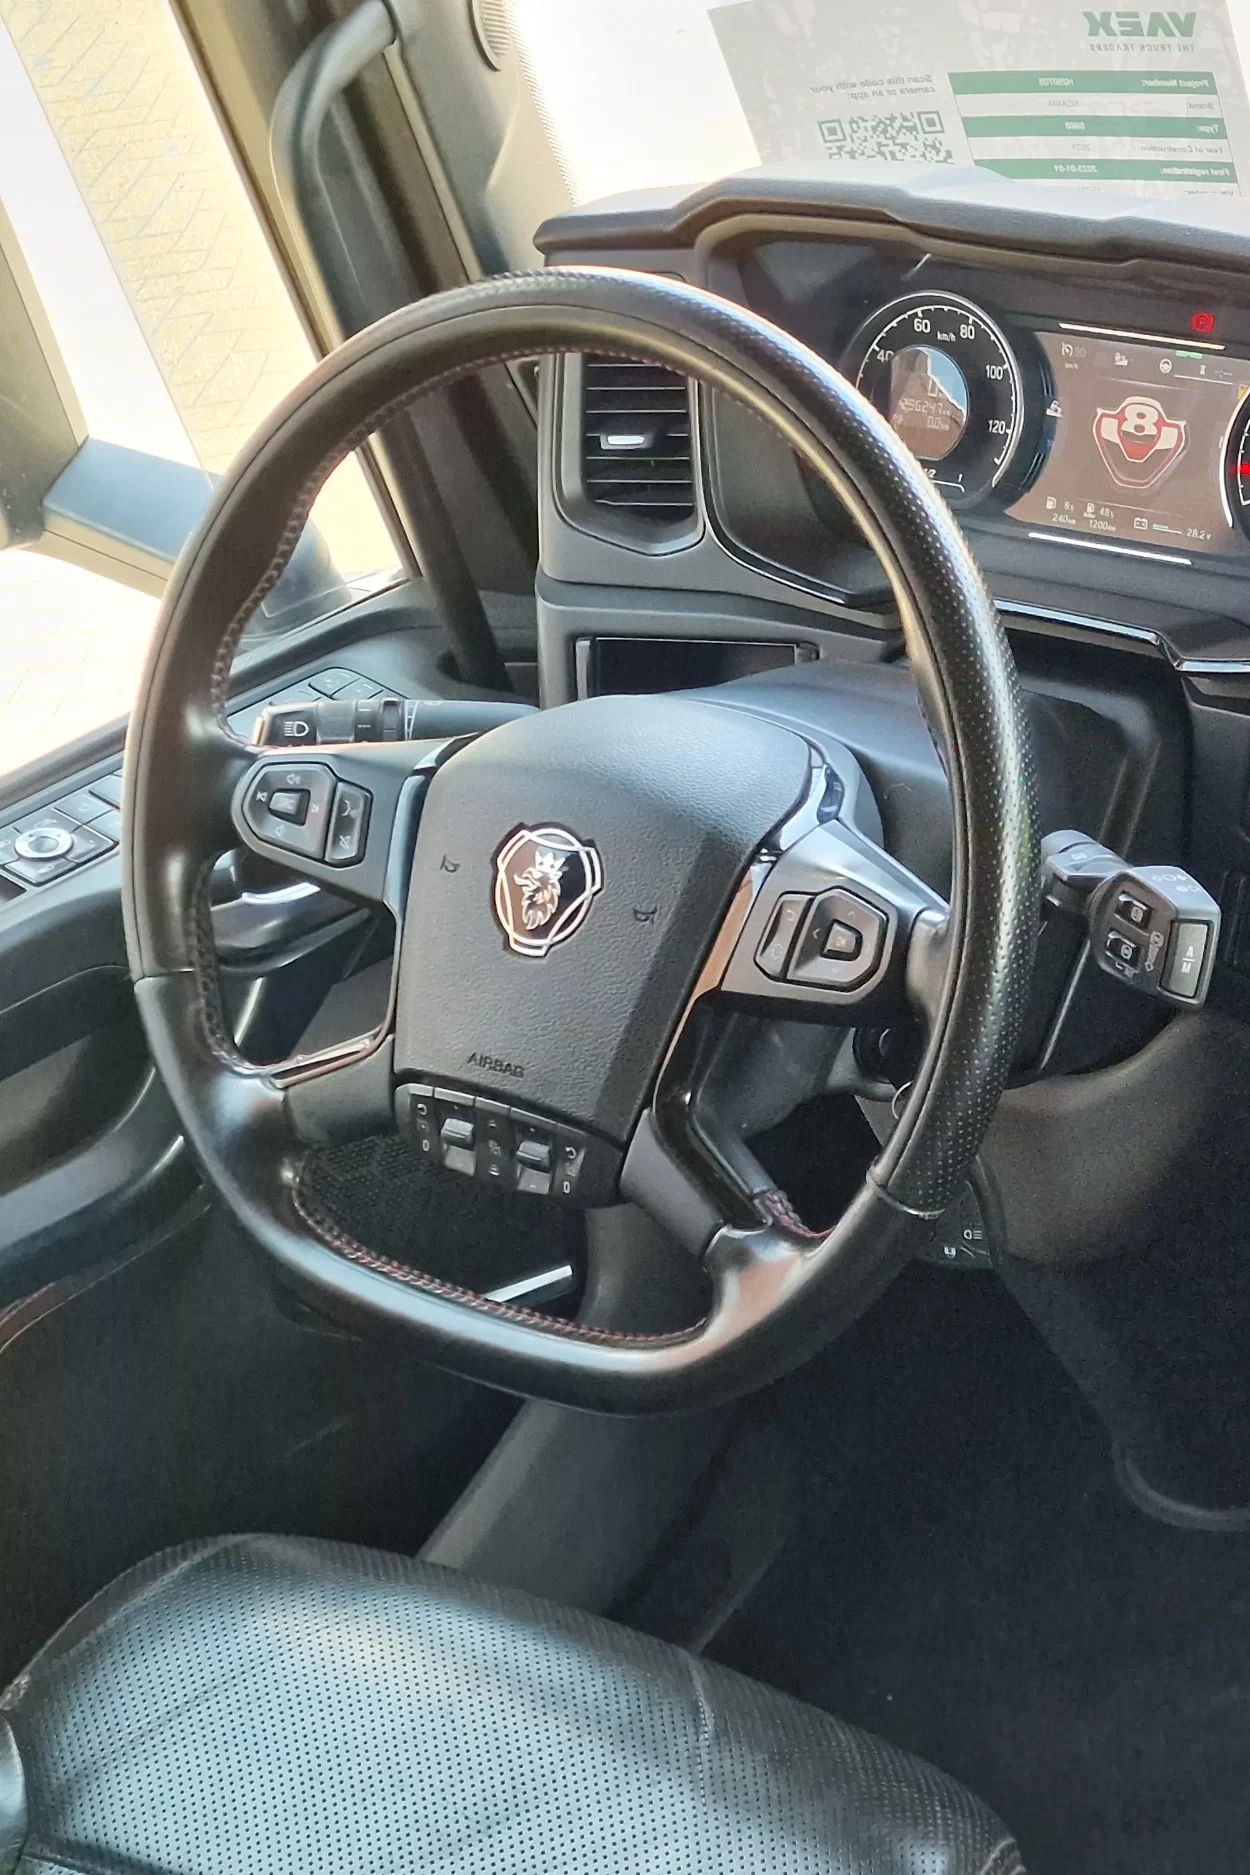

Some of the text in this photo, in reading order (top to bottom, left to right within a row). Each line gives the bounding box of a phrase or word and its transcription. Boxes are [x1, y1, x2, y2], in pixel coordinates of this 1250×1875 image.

[913, 319, 931, 333] 60
[959, 324, 976, 340] 80
[936, 330, 957, 342] km/h
[985, 364, 1004, 381] 100
[987, 419, 1007, 436] 120
[1185, 945, 1194, 957] A
[1181, 963, 1192, 975] M
[467, 1052, 525, 1079] AIRBAG
